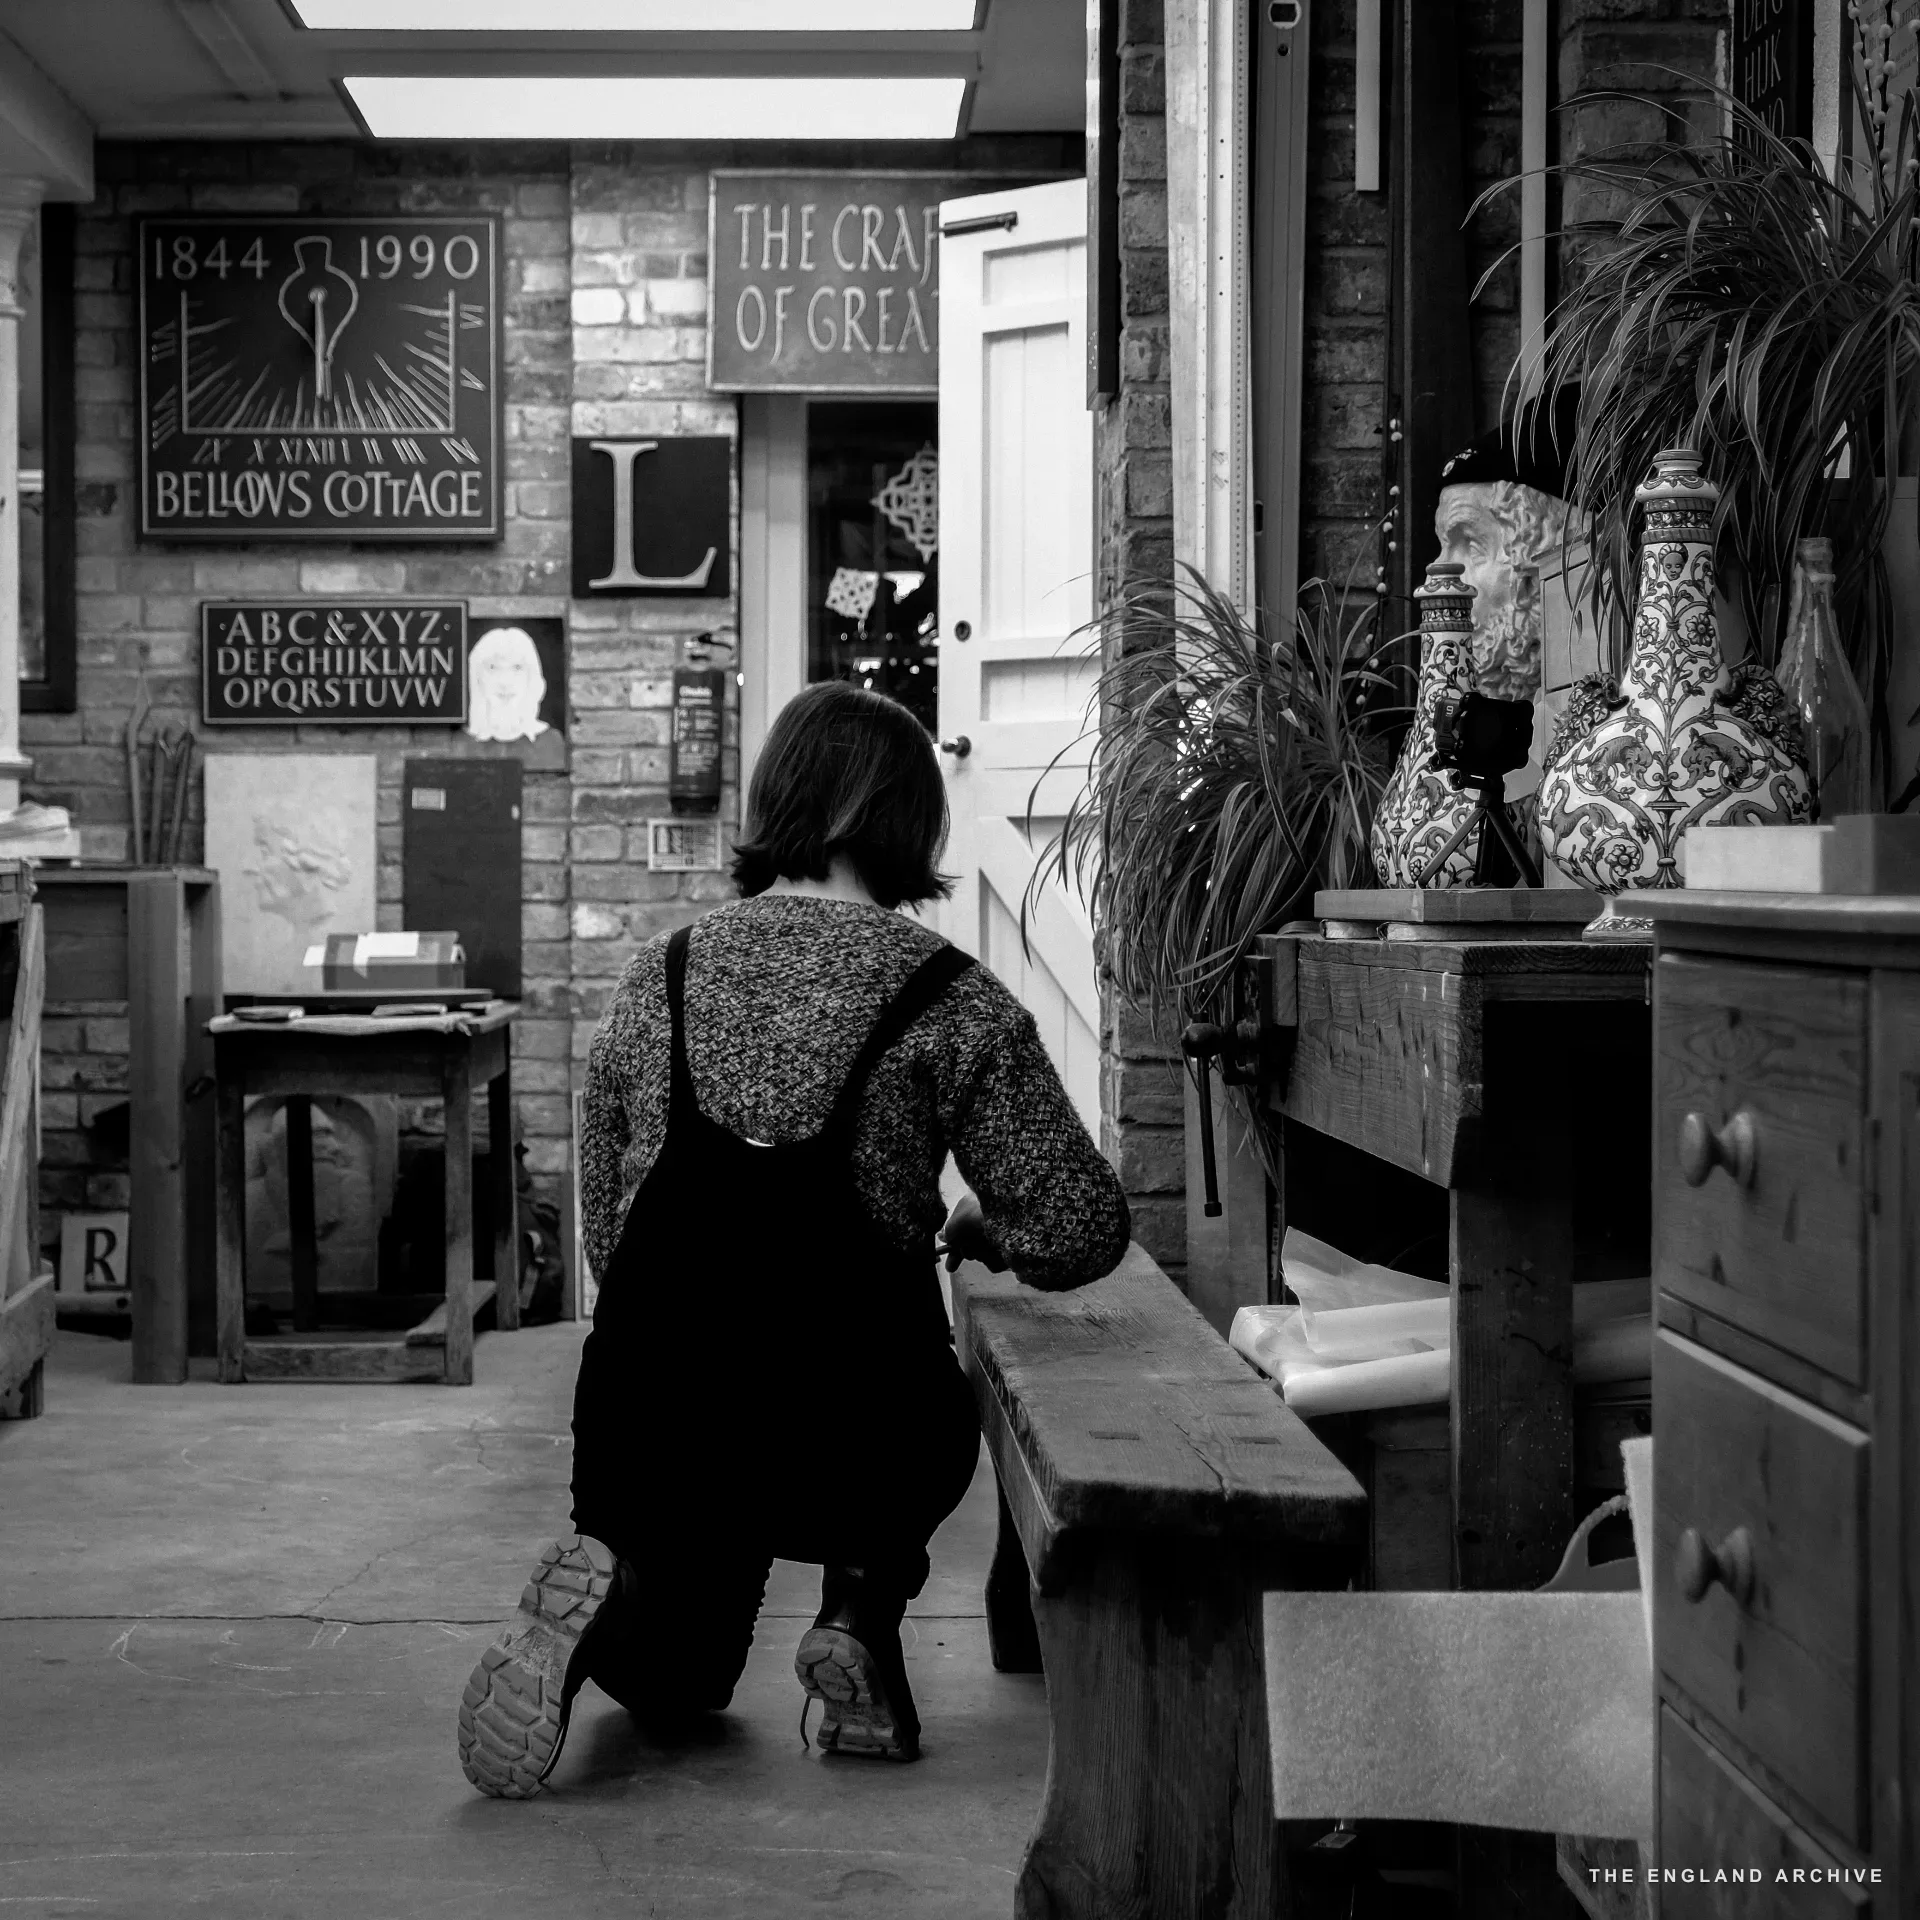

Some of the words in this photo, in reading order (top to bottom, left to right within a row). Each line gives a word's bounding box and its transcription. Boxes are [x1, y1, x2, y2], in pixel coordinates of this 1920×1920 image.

[1744, 28, 1782, 107] HIJK
[153, 234, 272, 281] 1844
[358, 234, 480, 281] 1990
[733, 203, 818, 271] THE
[831, 204, 939, 287] CRAF
[736, 284, 796, 365] OF
[806, 285, 939, 354] GREA
[155, 470, 313, 518] BELLOWS
[322, 470, 484, 518] COTTAGE
[588, 440, 718, 590] L
[222, 677, 447, 714] OPQRSTUVW
[85, 1227, 117, 1284] R
